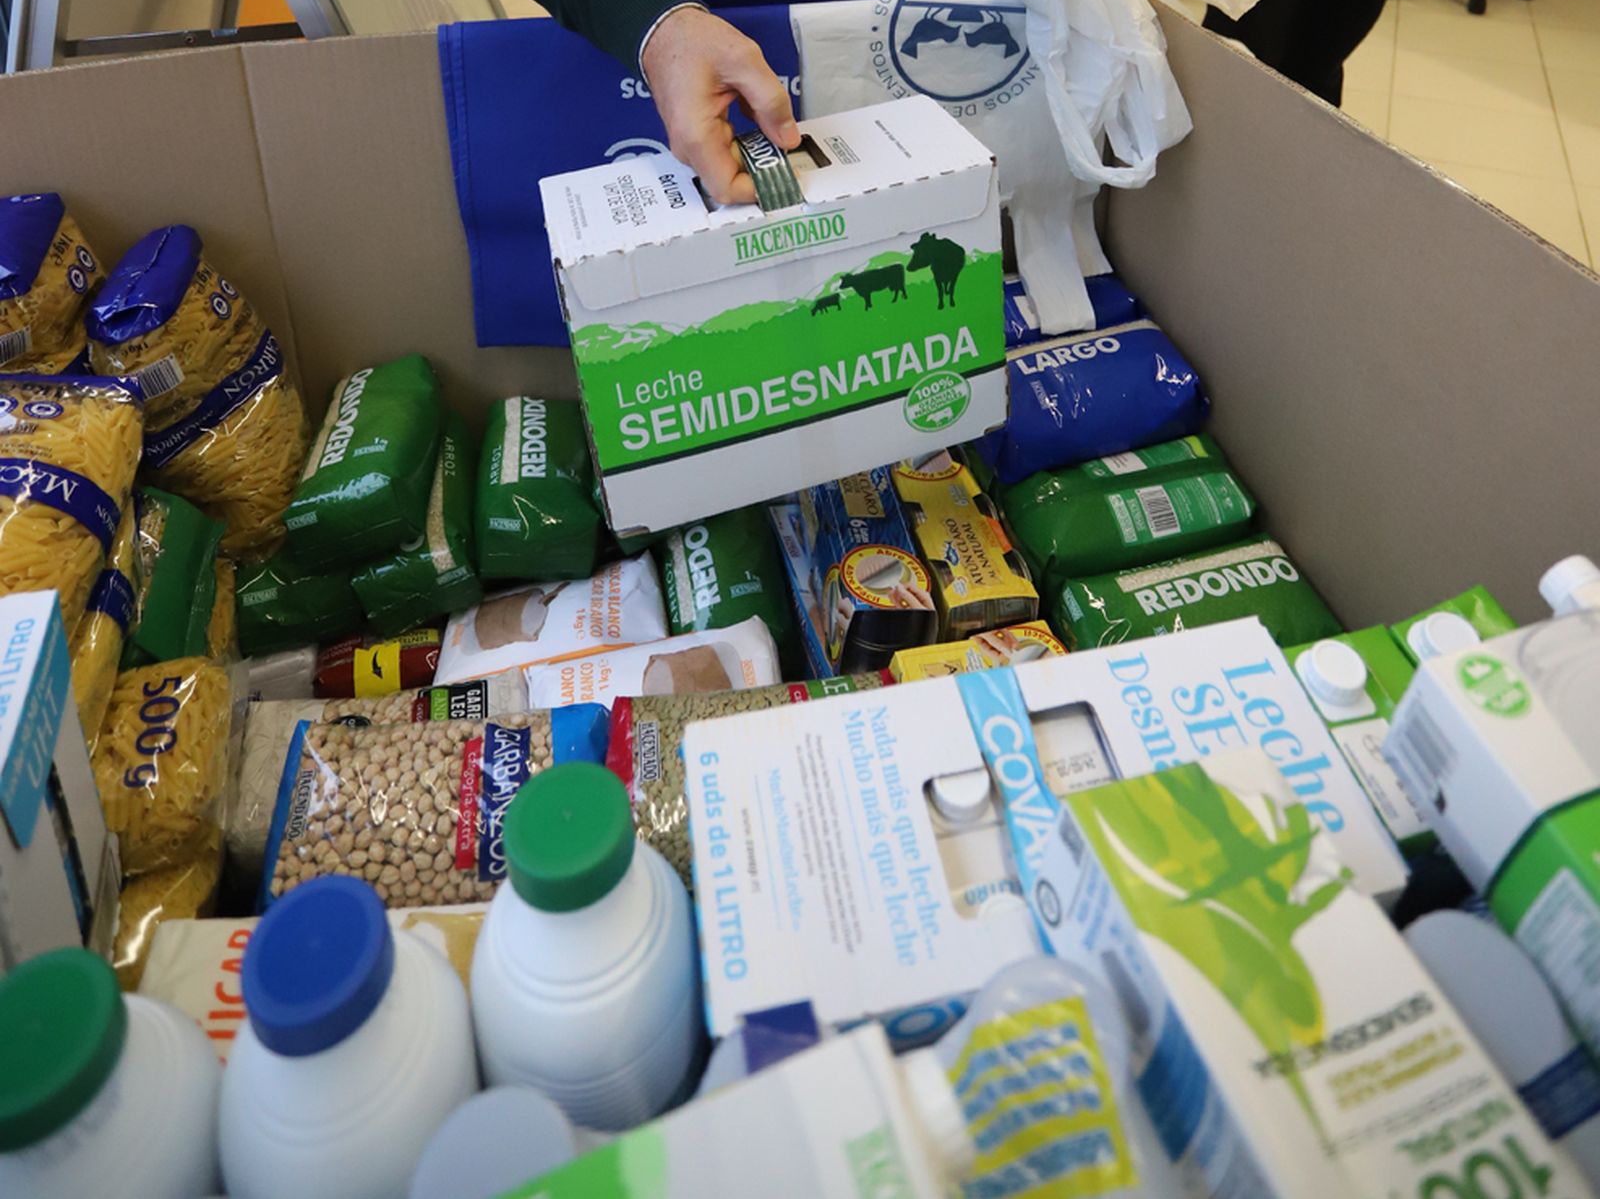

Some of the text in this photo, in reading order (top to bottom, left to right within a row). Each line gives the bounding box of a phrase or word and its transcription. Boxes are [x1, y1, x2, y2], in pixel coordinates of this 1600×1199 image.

[617, 174, 648, 228] SEMIDESNATADA
[638, 185, 659, 208] LECHE
[664, 186, 687, 210] LITRO
[736, 213, 846, 260] HACENDADO
[1016, 337, 1121, 376] LARGO
[616, 367, 702, 409] Leche
[619, 326, 980, 451] SEMIDESNATADA
[916, 376, 954, 400] 100%
[320, 367, 374, 469] REDONDO
[489, 444, 502, 487] ARROZ
[945, 517, 970, 551] CLARO
[685, 526, 720, 610] REDO
[1134, 557, 1300, 617] REDONDO
[10, 617, 35, 671] LITRO
[606, 597, 622, 640] BLANCO
[560, 666, 574, 706] LANCO
[579, 661, 593, 705] RANCO
[26, 678, 64, 788] UHT
[123, 675, 183, 789] 500 g
[867, 703, 896, 757] Nada
[1171, 681, 1250, 758] SE
[1220, 657, 1346, 834] Leche
[640, 722, 659, 781] HACENDADO
[287, 768, 314, 841] HACENDADO
[884, 764, 909, 804] más
[841, 707, 918, 968] Mucho más que leche
[896, 806, 921, 866] que
[699, 751, 750, 982] 6 uds de 1 LITRO
